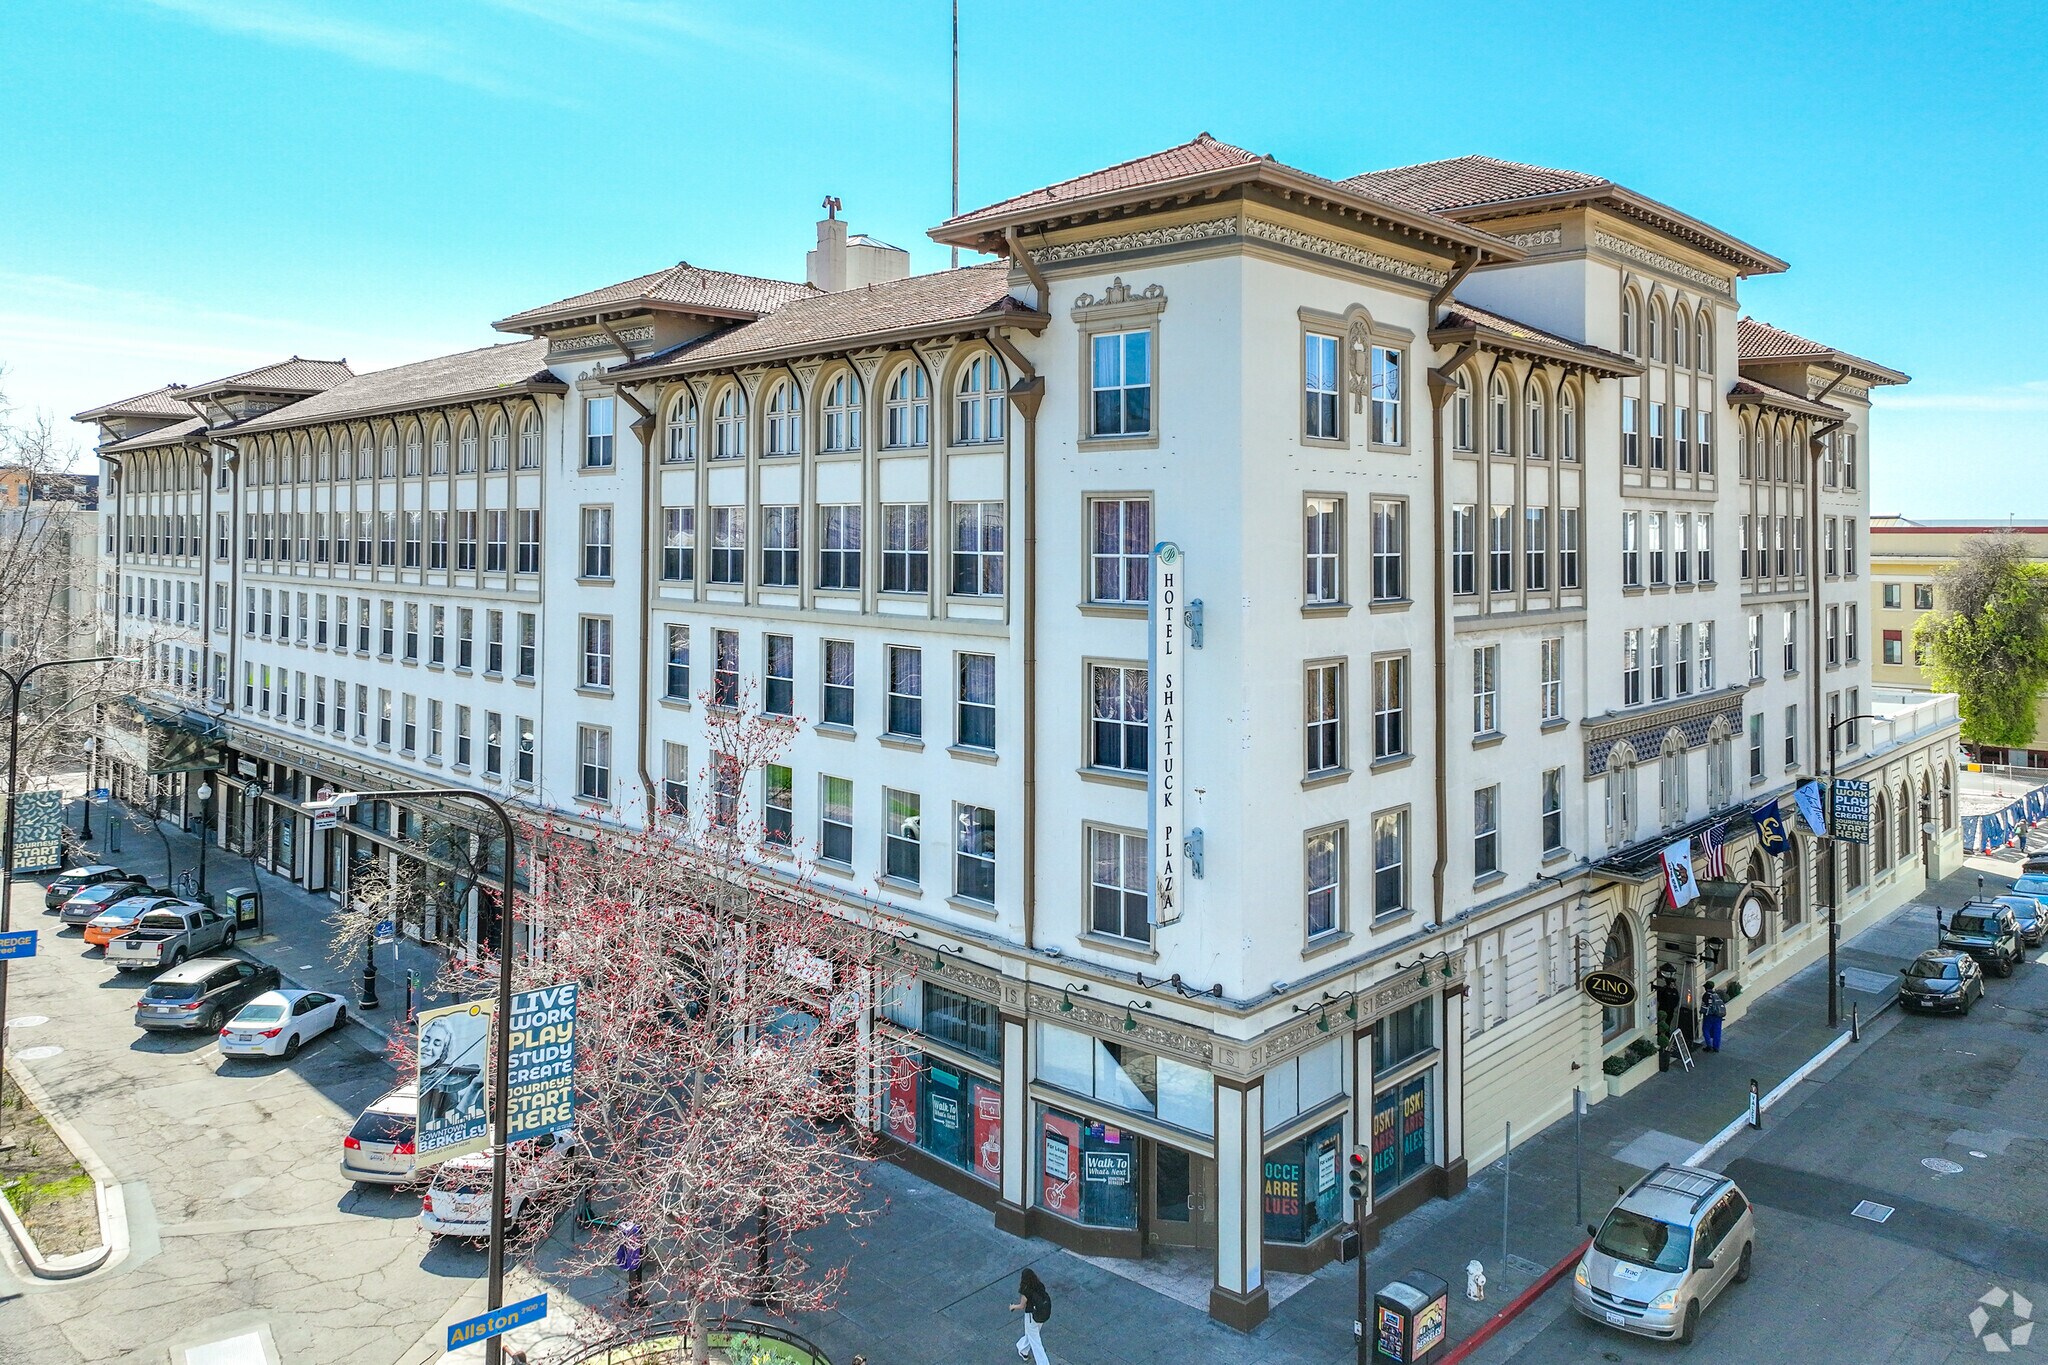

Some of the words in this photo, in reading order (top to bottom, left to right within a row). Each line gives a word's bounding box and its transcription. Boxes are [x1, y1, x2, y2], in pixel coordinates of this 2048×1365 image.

[1163, 572, 1174, 656] HOTEL
[1163, 673, 1174, 807] SHATTUCK
[1835, 788, 1868, 798] WORK
[1836, 779, 1868, 791] LIVE
[1835, 795, 1868, 808] PLAY
[1835, 804, 1868, 814] STUDY
[1835, 812, 1868, 821] CREATE
[1758, 817, 1783, 847] Cal
[1835, 823, 1868, 832] START
[1835, 830, 1868, 841] HERE
[13, 846, 59, 859] START
[14, 839, 59, 851] JOURNEYS
[13, 855, 58, 869] HERE
[1163, 826, 1173, 910] PLAZA
[1592, 977, 1628, 995] ZINO
[510, 984, 575, 1015] LIVE
[509, 1005, 574, 1031] WORK
[508, 1021, 573, 1051] PLAY
[508, 1042, 572, 1069] STUDY
[507, 1060, 572, 1085] CREATE
[507, 1075, 572, 1099] JOURNEYS
[506, 1087, 572, 1115] START
[934, 1101, 949, 1112] Walk
[949, 1103, 957, 1114] To
[1404, 1089, 1424, 1118] OSKI
[506, 1102, 571, 1134] HERE
[1374, 1106, 1394, 1136] OSKI
[418, 1123, 467, 1142] DOWNTOWN
[418, 1124, 487, 1153] BERKELEY
[1404, 1127, 1424, 1156] ALES
[1088, 1157, 1115, 1168] Walk
[1117, 1158, 1128, 1168] To
[1264, 1162, 1299, 1180] OCCE
[1374, 1146, 1395, 1175] ALES
[1111, 1168, 1127, 1176] Next
[1264, 1180, 1299, 1198] ARRE
[1265, 1197, 1299, 1215] LUES
[450, 1311, 519, 1346] Allston
